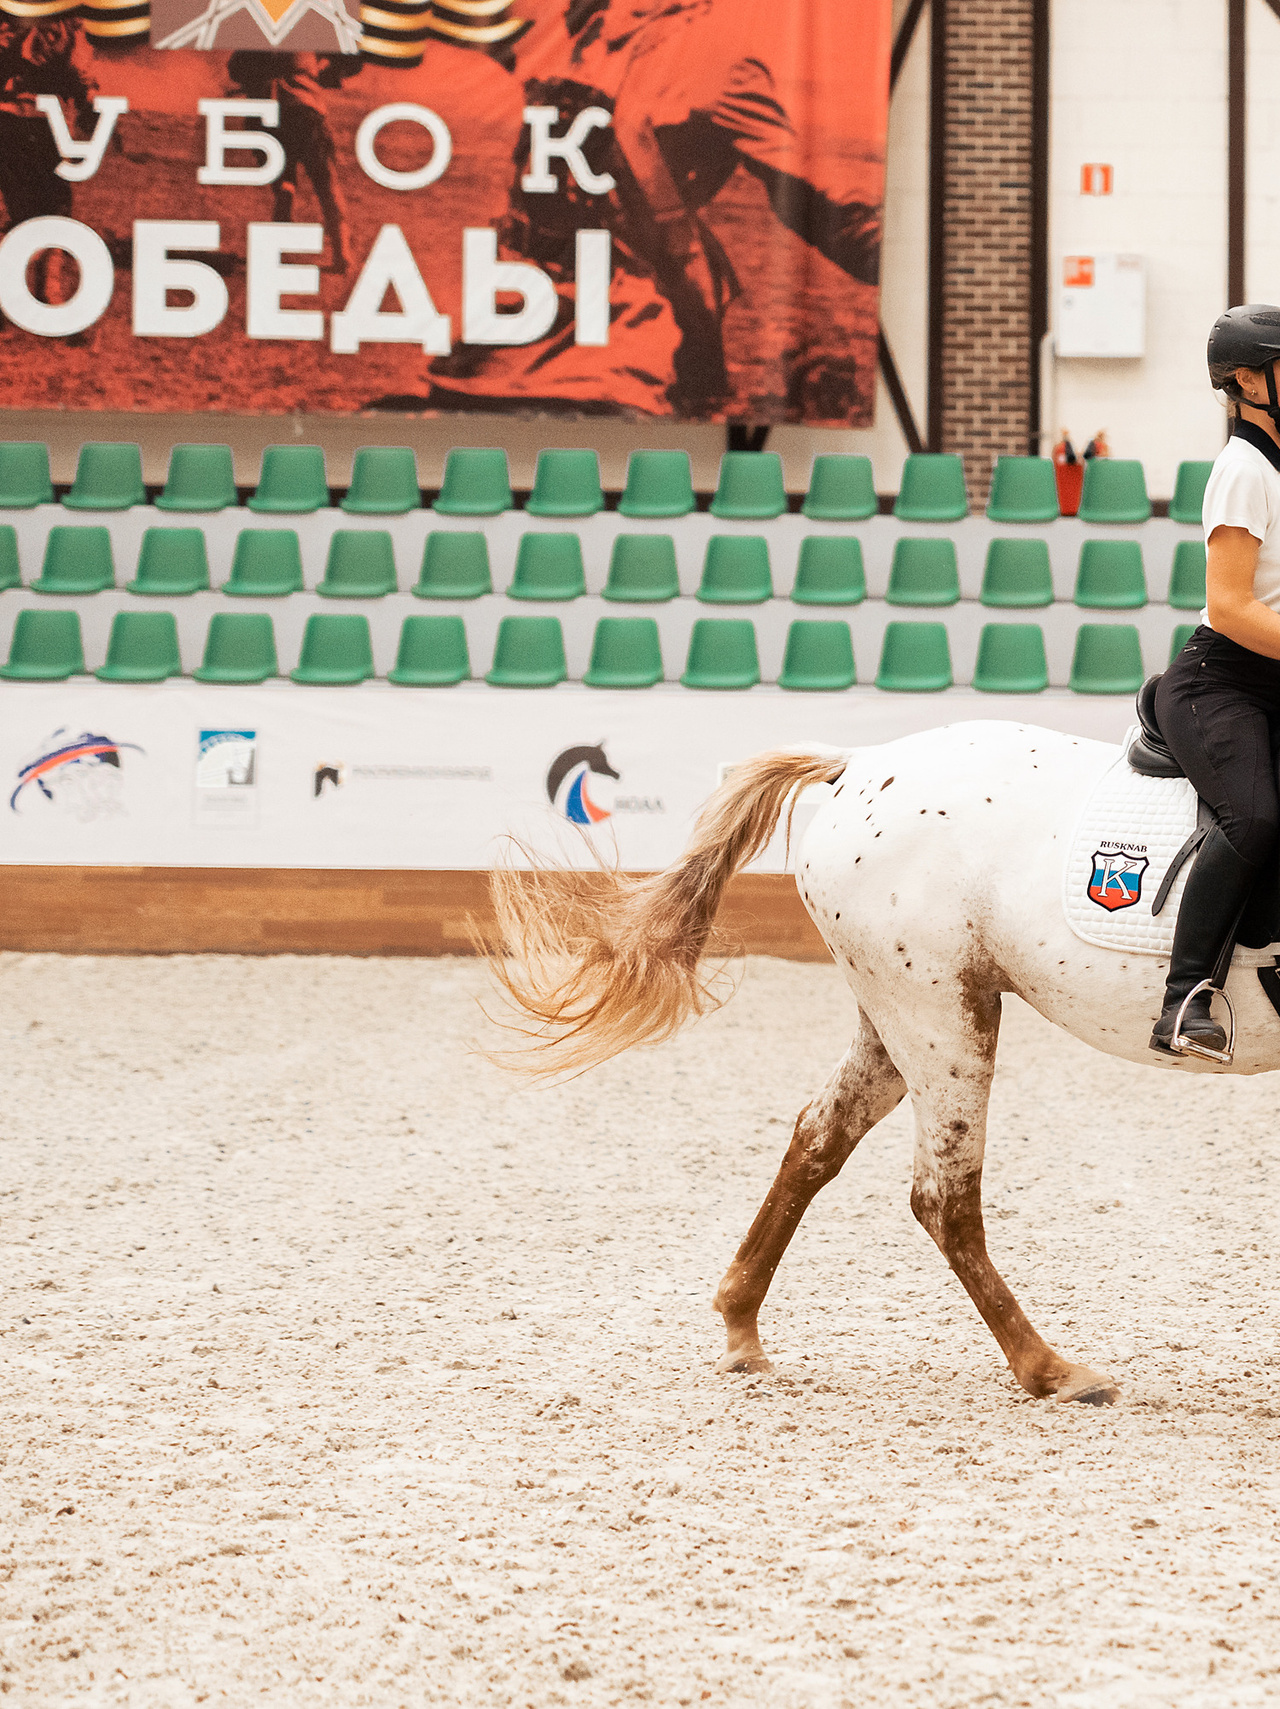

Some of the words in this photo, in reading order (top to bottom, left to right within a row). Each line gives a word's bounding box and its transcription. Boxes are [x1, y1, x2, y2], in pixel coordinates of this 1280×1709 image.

[37, 95, 616, 195] УБОК
[0, 215, 611, 356] ОБЕДЫ
[1097, 858, 1137, 900] K
[1099, 840, 1148, 853] RUSKNAB
